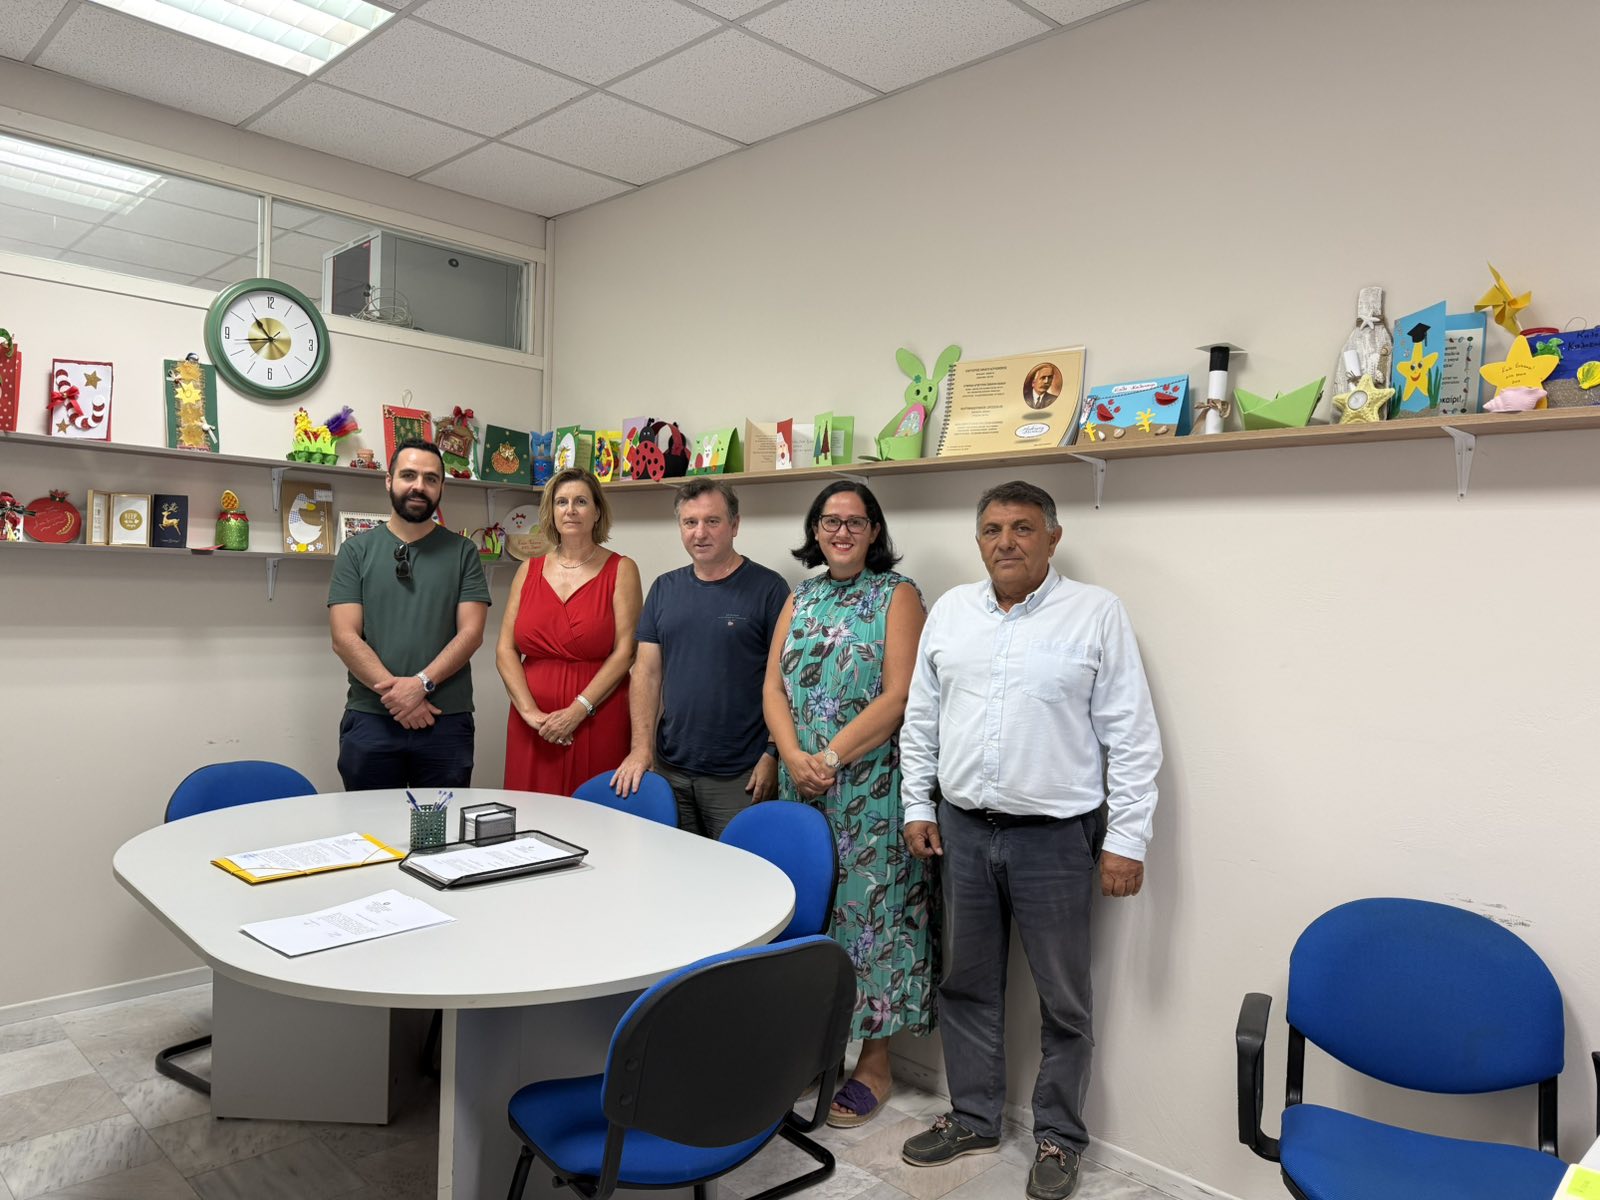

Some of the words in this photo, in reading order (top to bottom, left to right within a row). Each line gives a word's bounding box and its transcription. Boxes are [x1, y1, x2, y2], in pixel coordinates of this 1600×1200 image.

[267, 296, 275, 309] 12
[224, 326, 230, 339] 9
[308, 339, 314, 351] 3
[267, 367, 273, 380] 6
